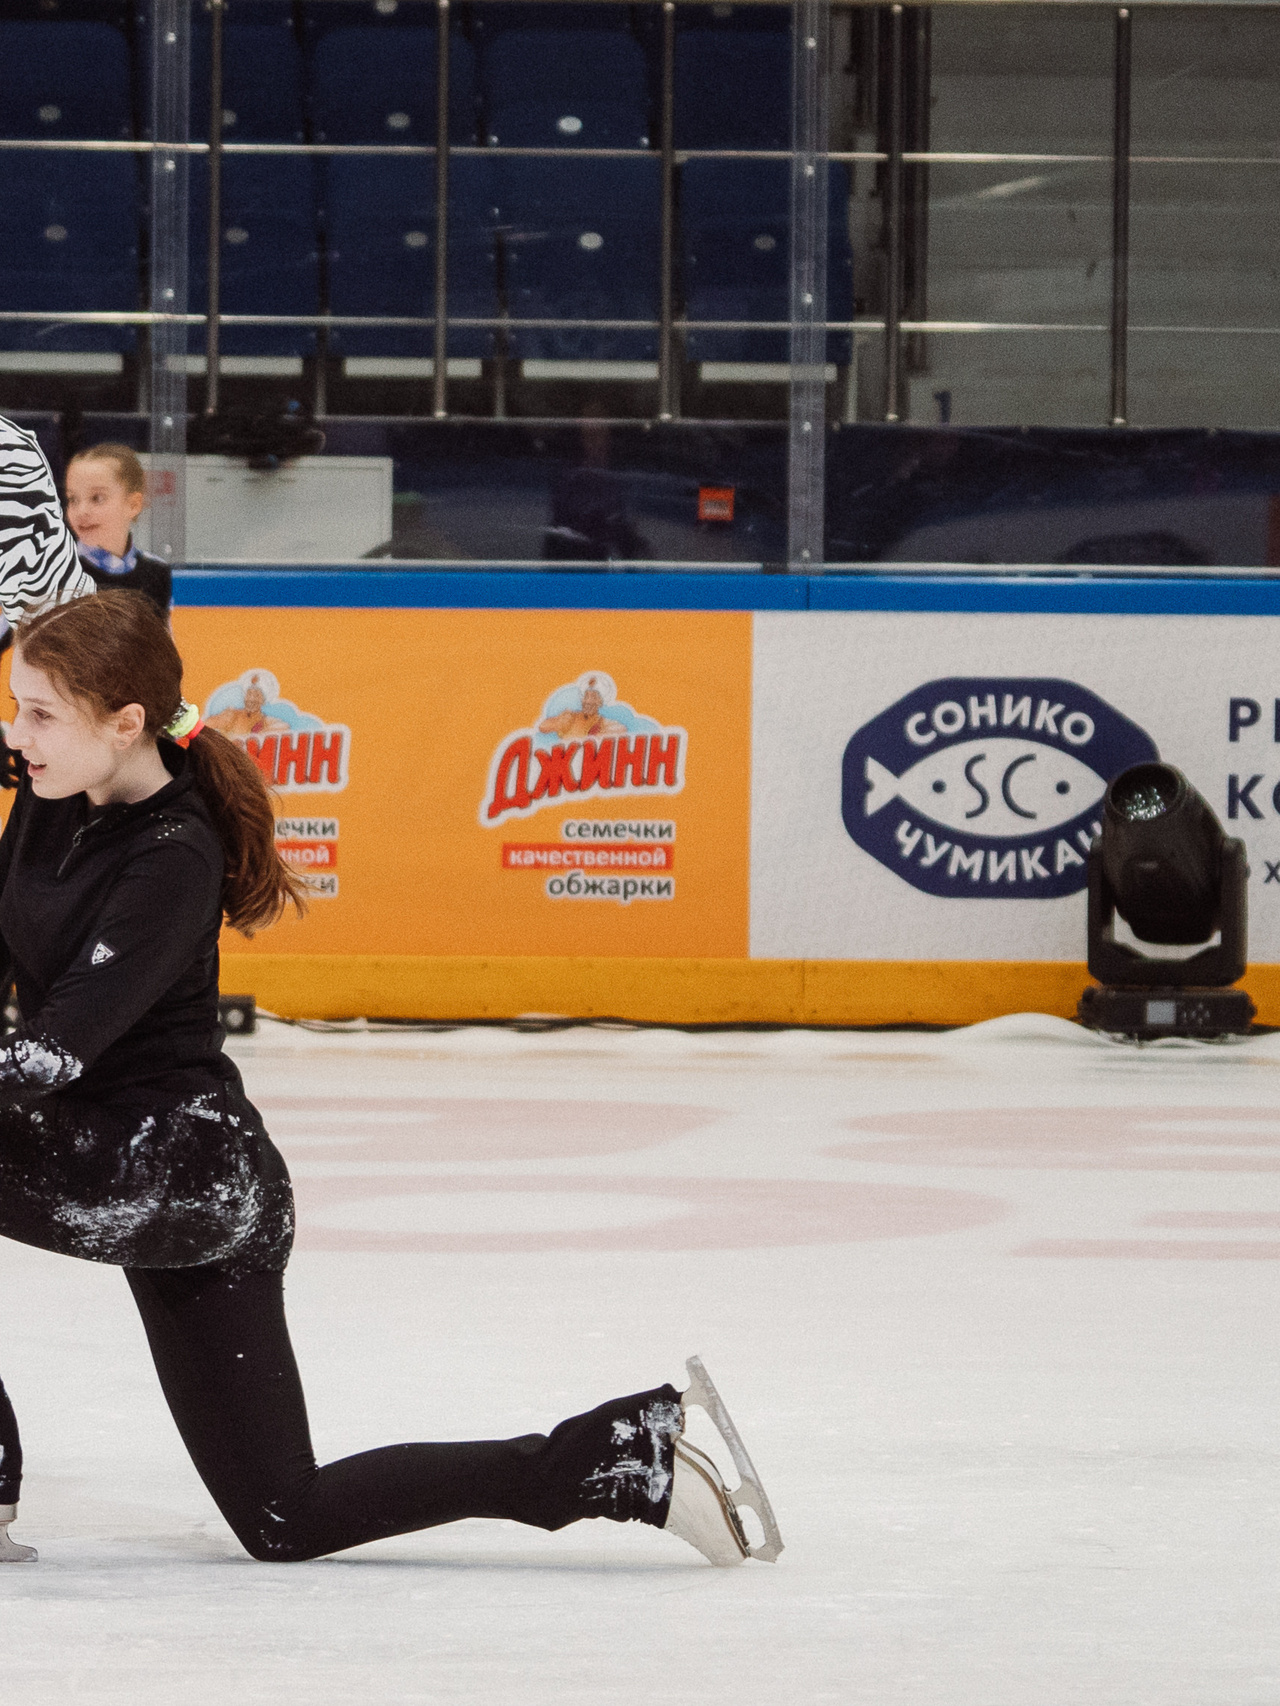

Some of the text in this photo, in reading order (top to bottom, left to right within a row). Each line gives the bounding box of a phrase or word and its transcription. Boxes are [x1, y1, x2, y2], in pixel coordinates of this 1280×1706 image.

[905, 693, 1096, 747] СОНИКО
[563, 820, 674, 840] семечки
[508, 846, 668, 868] качественной
[547, 871, 673, 900] обжарки
